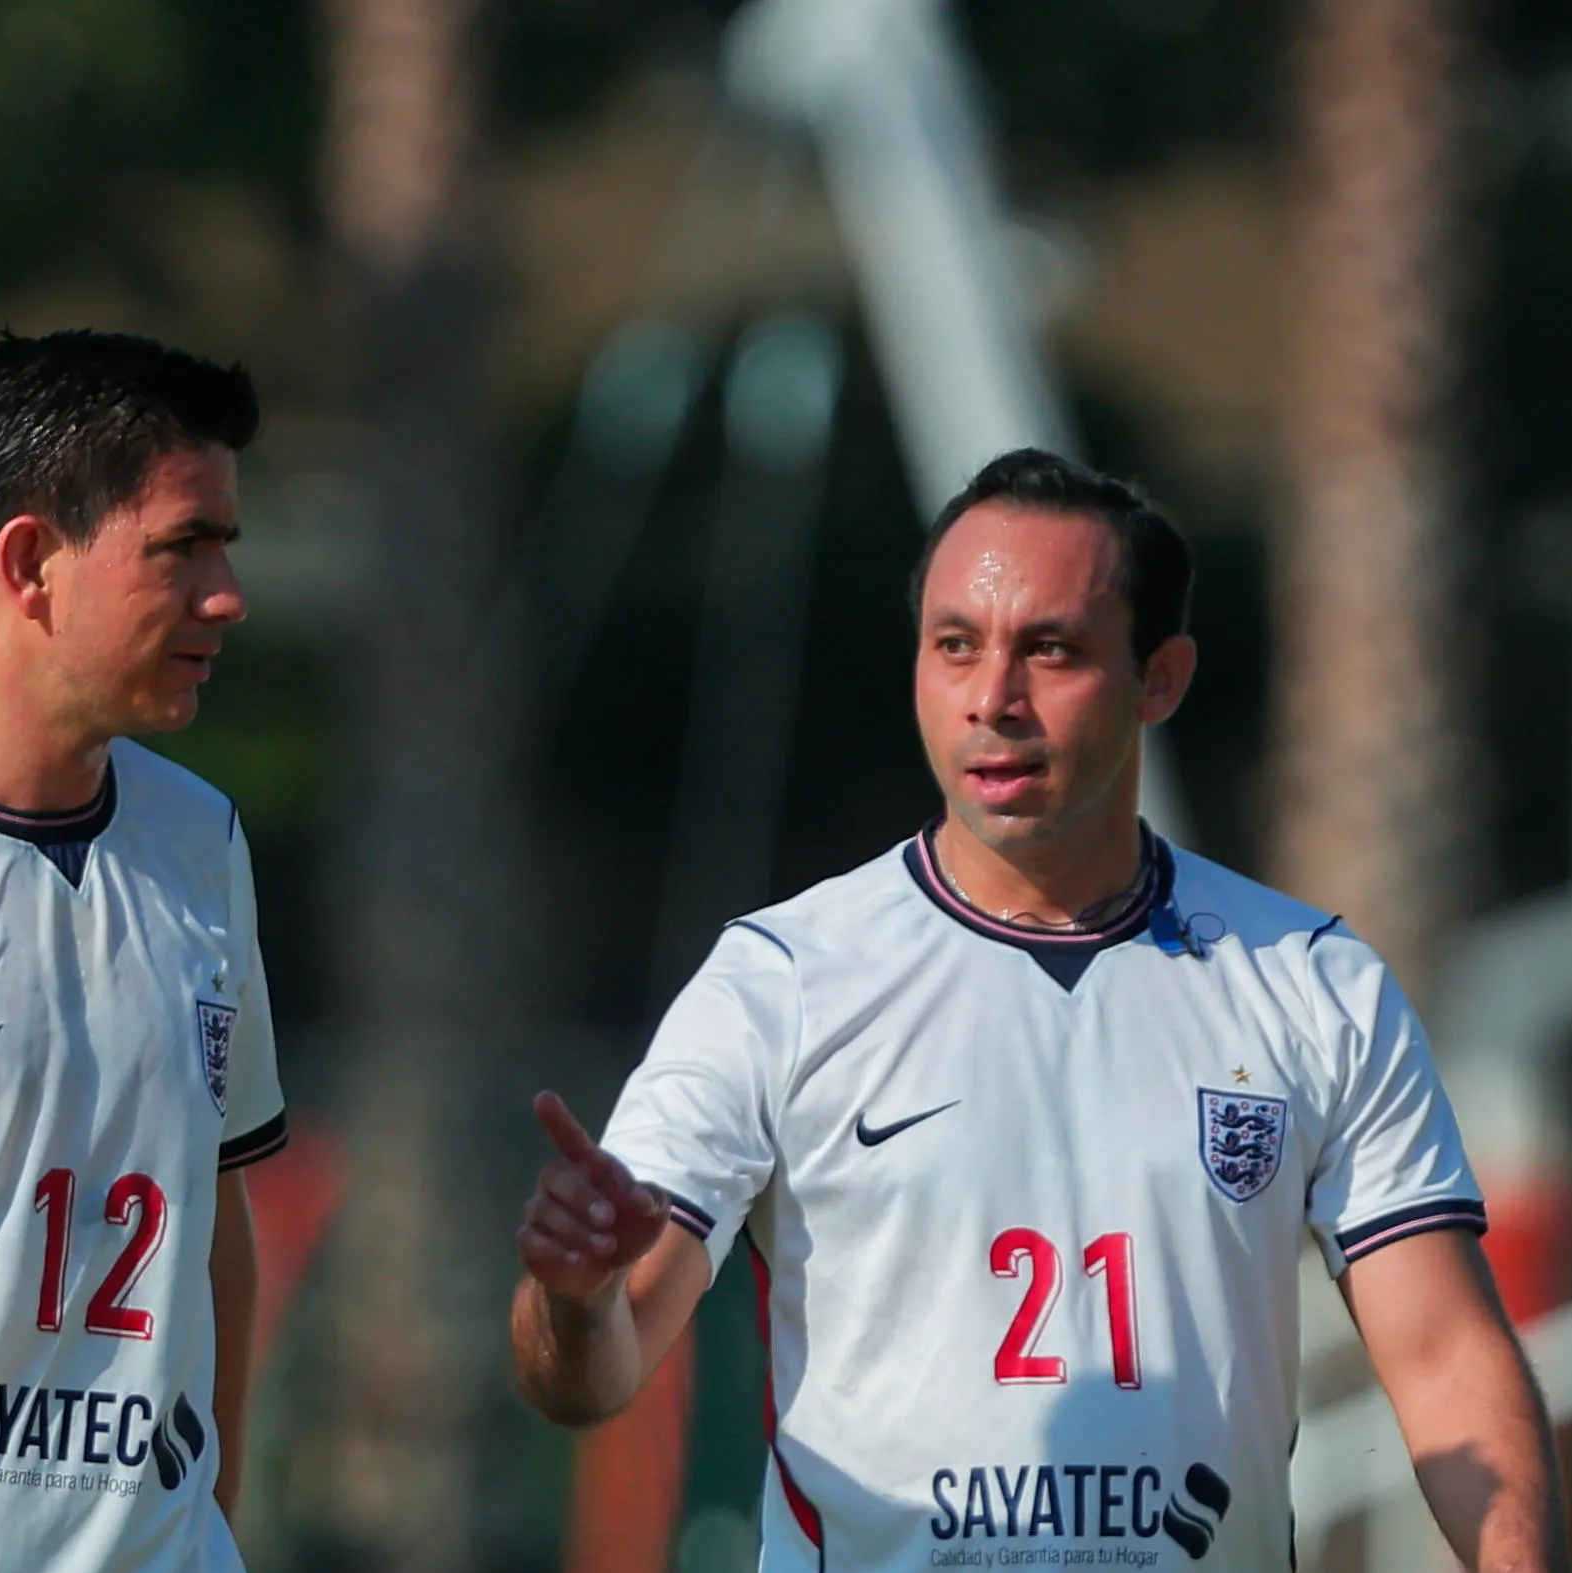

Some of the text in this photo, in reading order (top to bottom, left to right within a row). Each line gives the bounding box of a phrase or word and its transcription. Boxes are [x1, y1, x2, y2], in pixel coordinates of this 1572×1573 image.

[34, 1167, 169, 1342] 12
[989, 1225, 1142, 1391] 21
[45, 1472, 77, 1491] para
[80, 1473, 94, 1491] tu
[97, 1475, 143, 1498] Hogar
[930, 1464, 1162, 1541] SAYATEC
[930, 1548, 982, 1567] Calidad
[986, 1552, 995, 1569] y
[1063, 1550, 1094, 1568] para
[1098, 1548, 1113, 1564] tu
[1115, 1546, 1159, 1570] Hogar
